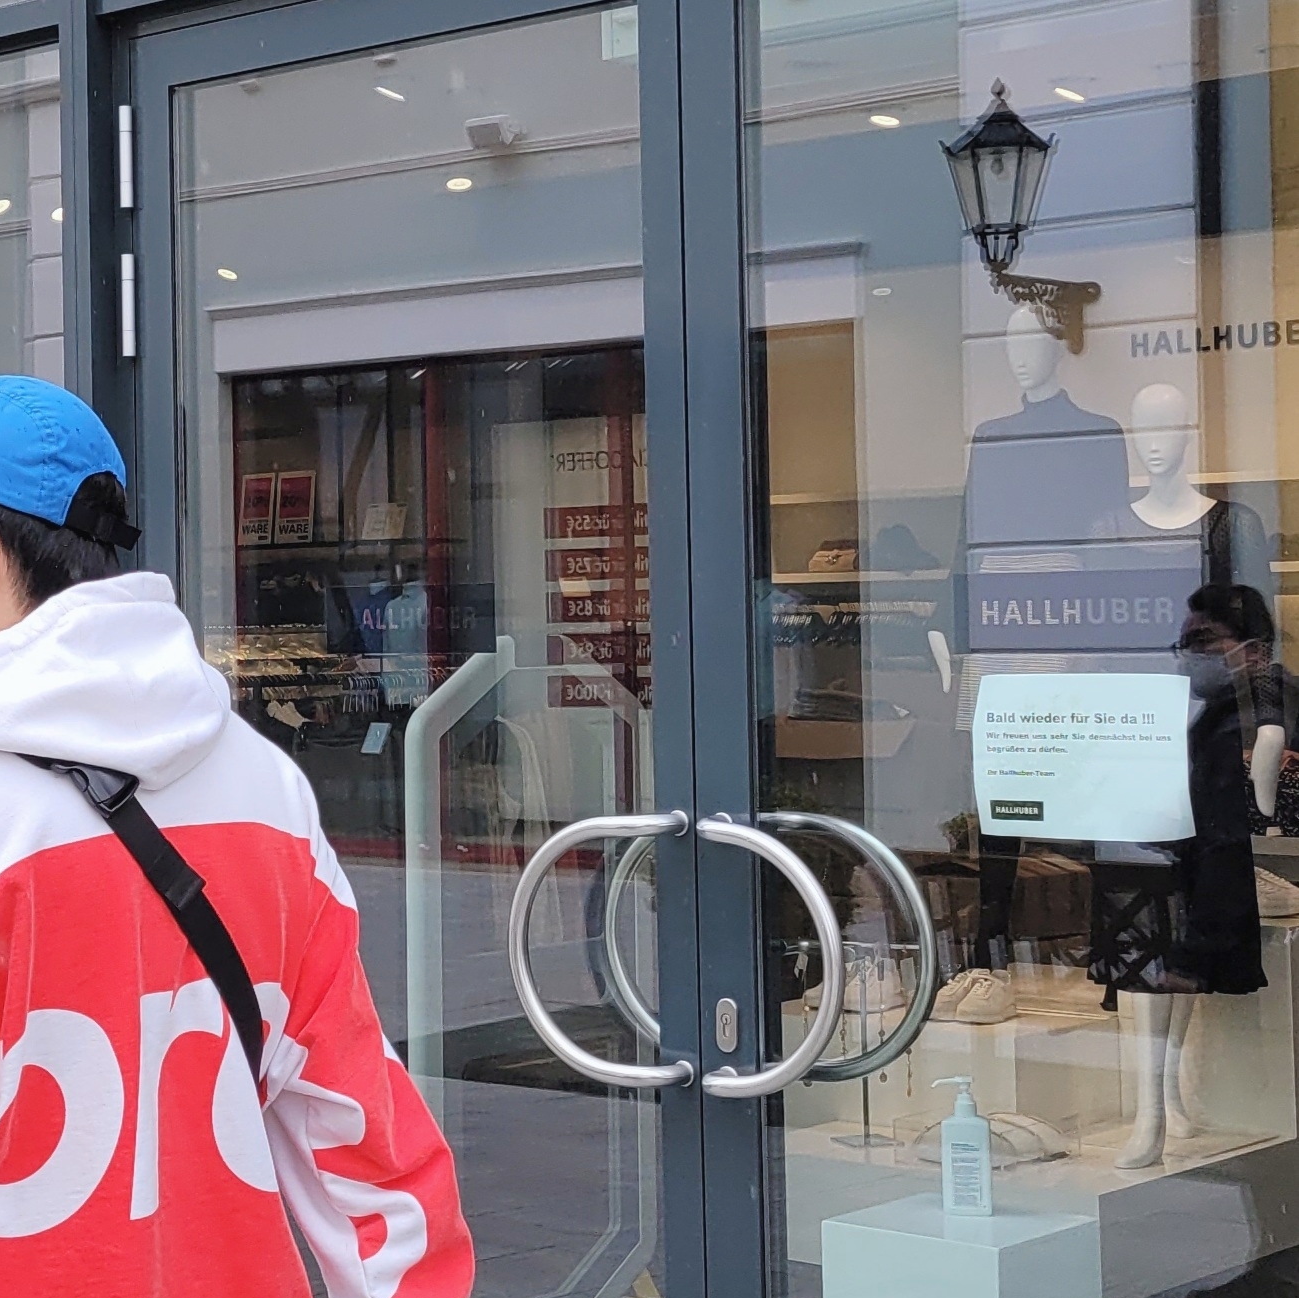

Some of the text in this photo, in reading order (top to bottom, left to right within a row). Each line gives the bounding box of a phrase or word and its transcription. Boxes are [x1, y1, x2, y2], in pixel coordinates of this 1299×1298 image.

[1131, 319, 1299, 357] HALLHUBE
[241, 523, 269, 536] WARE
[278, 523, 309, 535] WARE
[981, 597, 1174, 626] HALLHUBER
[986, 712, 1155, 725] Bald wieder für Sie da !!!
[995, 805, 1039, 815] HALLHUBER
